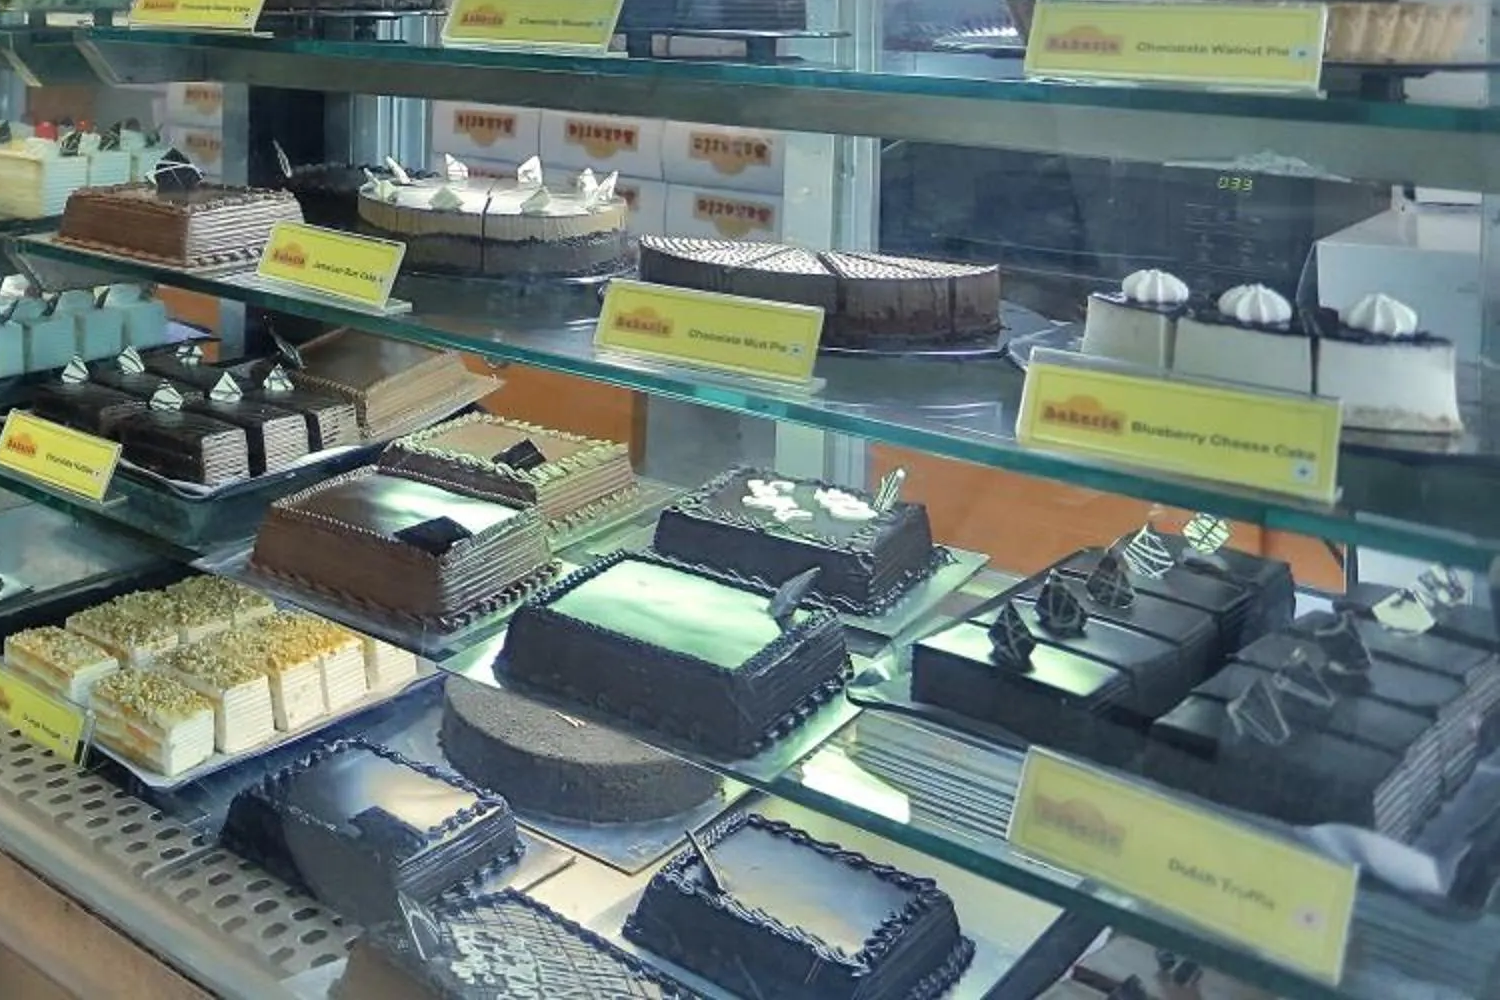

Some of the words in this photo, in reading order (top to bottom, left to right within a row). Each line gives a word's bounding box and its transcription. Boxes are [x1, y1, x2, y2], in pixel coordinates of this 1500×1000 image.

[1136, 41, 1207, 55] Chocolate
[1212, 43, 1262, 56] Walnut
[1266, 47, 1289, 57] Pie
[1131, 421, 1207, 446] Blueberry
[1209, 433, 1271, 454] Cheese
[1273, 444, 1316, 461] Cake
